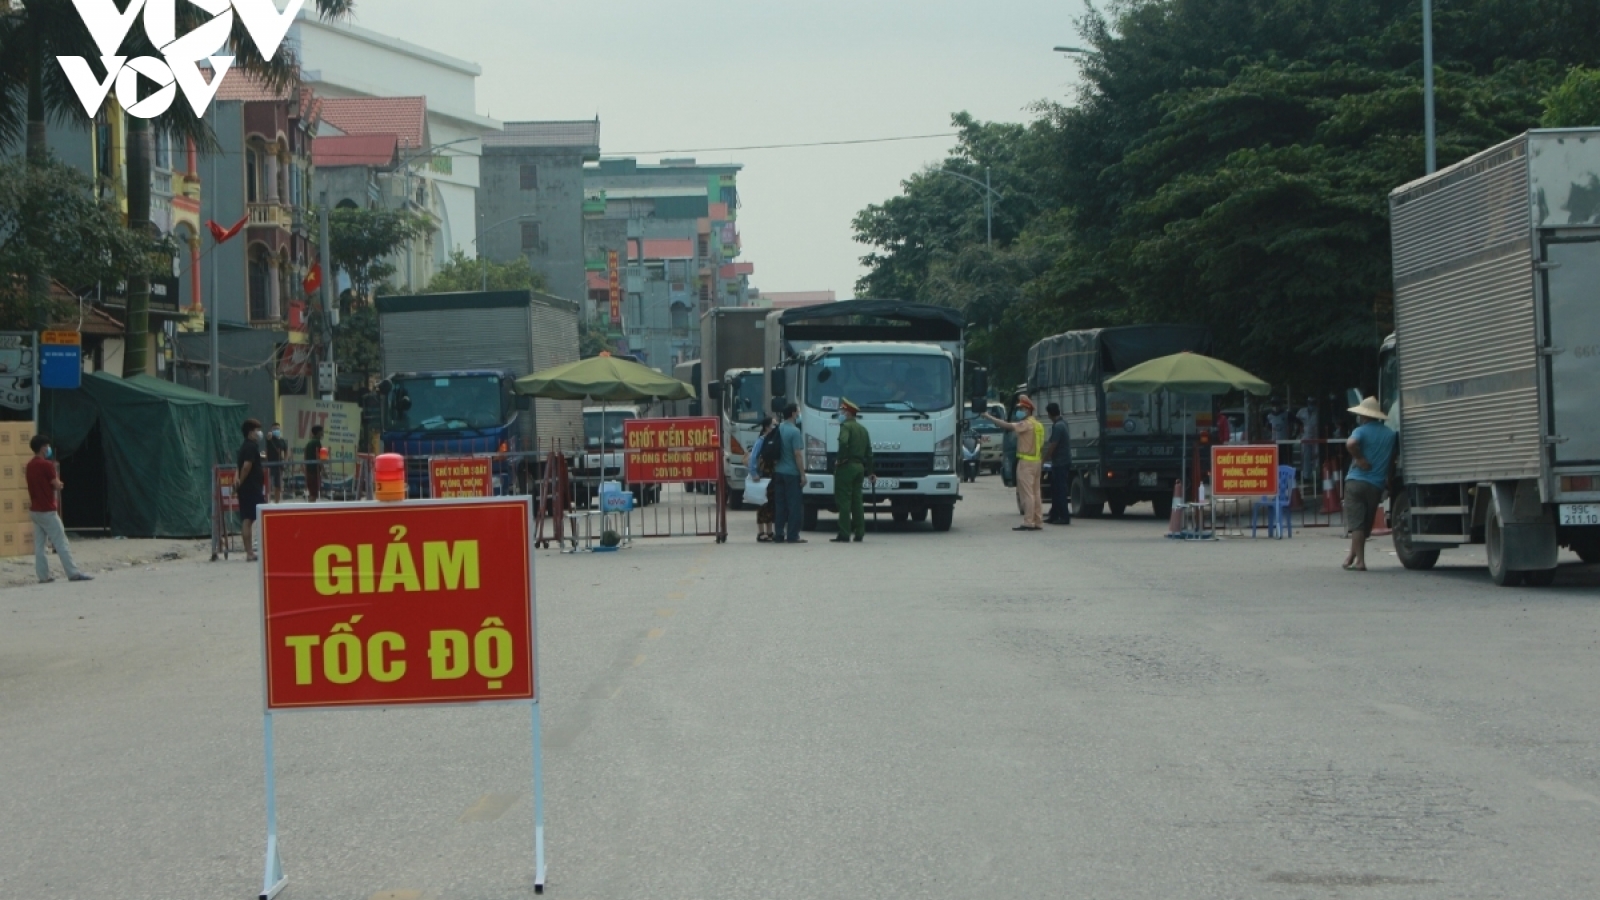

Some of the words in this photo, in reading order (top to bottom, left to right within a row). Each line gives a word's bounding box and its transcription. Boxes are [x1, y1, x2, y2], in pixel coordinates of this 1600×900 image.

[629, 424, 656, 447] CHỐT
[658, 423, 685, 447] KIỂM
[688, 425, 714, 446] SOÁT
[694, 451, 714, 464] DỊCH
[1216, 451, 1235, 464] CHỐT
[1235, 451, 1254, 464] KIỂM
[1255, 453, 1273, 464] SOÁT
[653, 466, 693, 477] COVID-19
[1246, 465, 1268, 477] CHỐNG
[1223, 479, 1238, 490] DỊCH
[1239, 479, 1268, 488] COVID-19
[1571, 504, 1590, 514] 99C
[1564, 514, 1598, 524] 211.10
[312, 525, 480, 596] GIẢM
[285, 615, 408, 685] TỐC
[427, 616, 514, 689] ĐỘ
